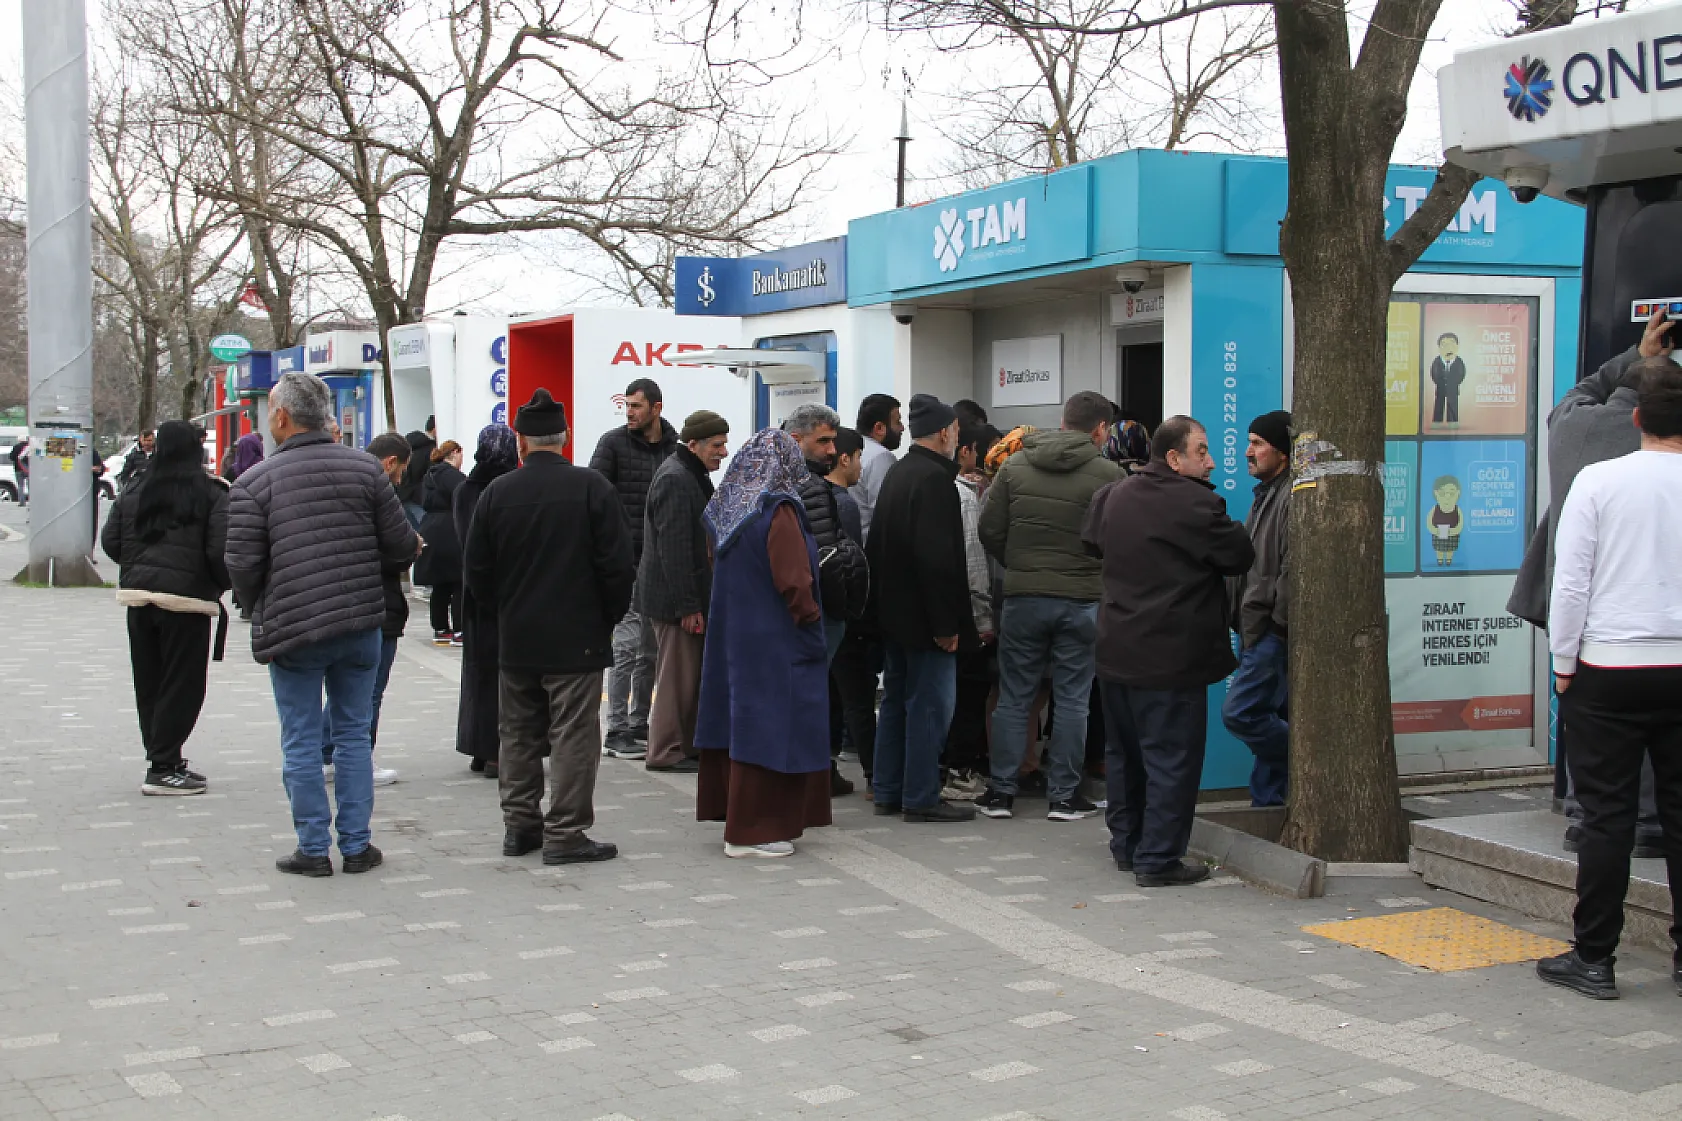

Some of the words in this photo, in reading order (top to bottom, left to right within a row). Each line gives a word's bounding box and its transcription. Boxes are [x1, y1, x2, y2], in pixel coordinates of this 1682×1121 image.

[1562, 34, 1682, 107] QNB
[967, 197, 1026, 250] TAM
[1395, 185, 1497, 233] TM
[752, 258, 827, 296] Bankamatik
[1224, 340, 1237, 372] 826
[1224, 393, 1237, 423] 222
[1224, 428, 1239, 474] (850)
[1477, 466, 1510, 481] GÖZÜ
[1422, 618, 1480, 633] İNTERNET
[1422, 635, 1471, 650] HERKES
[1473, 633, 1498, 650] İÇİN
[1422, 651, 1490, 668] YENİLENDİ!
